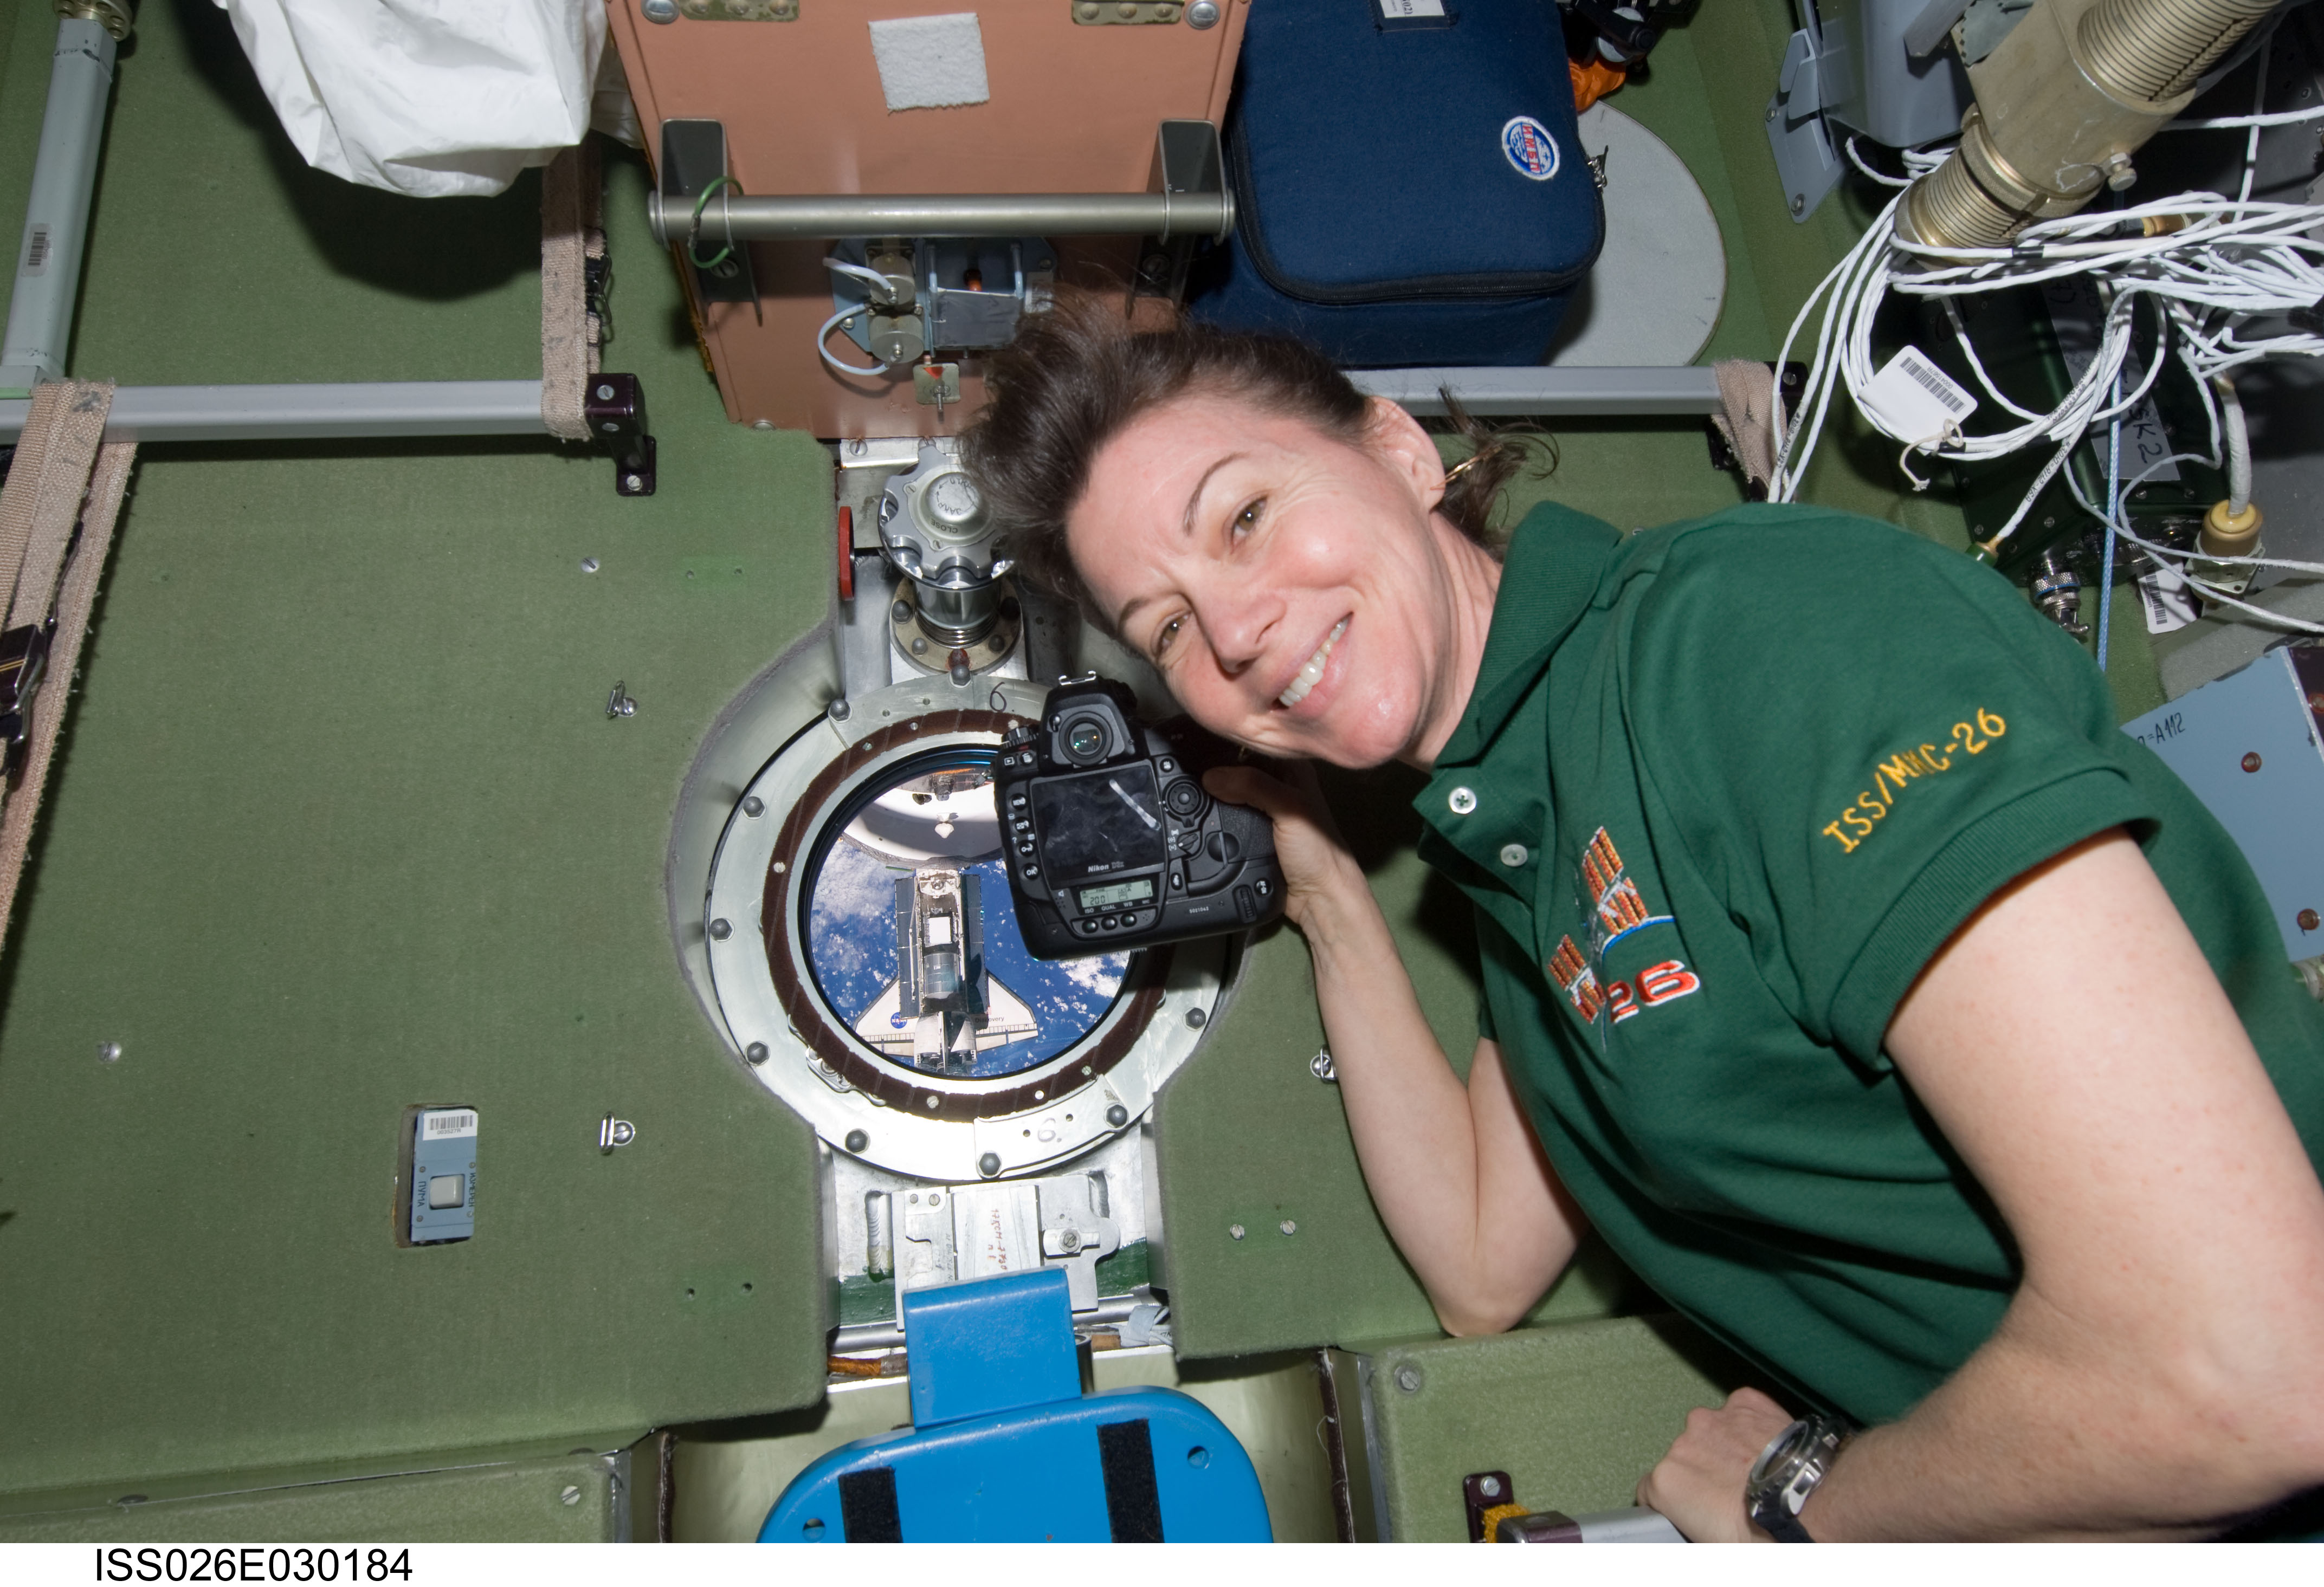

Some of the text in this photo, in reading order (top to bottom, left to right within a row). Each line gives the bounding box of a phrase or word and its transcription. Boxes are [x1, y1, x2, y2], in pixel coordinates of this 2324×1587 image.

[1523, 125, 1540, 172] ИМБП
[931, 519, 959, 534] CLOSE
[989, 682, 1007, 712] 6
[1087, 863, 1109, 873] Nikon
[1089, 896, 1106, 906] 200
[1609, 960, 1701, 1024] 26
[418, 1181, 427, 1207] ПУМА
